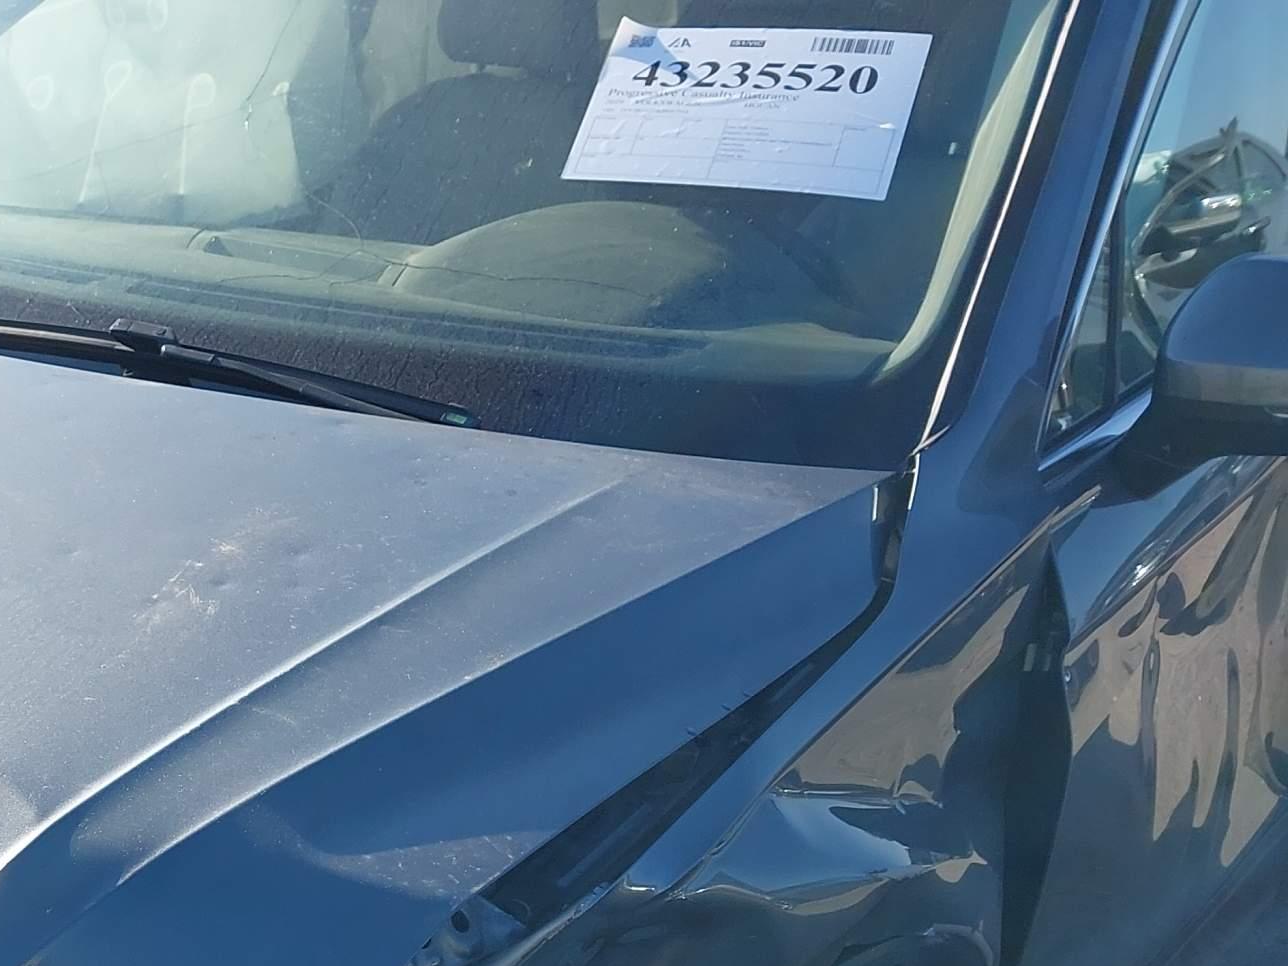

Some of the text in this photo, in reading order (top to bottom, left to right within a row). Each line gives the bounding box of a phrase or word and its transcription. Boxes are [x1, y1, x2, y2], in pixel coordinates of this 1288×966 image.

[632, 59, 879, 95] 43235520
[681, 88, 733, 101] Casualty
[739, 90, 800, 102] Insurance
